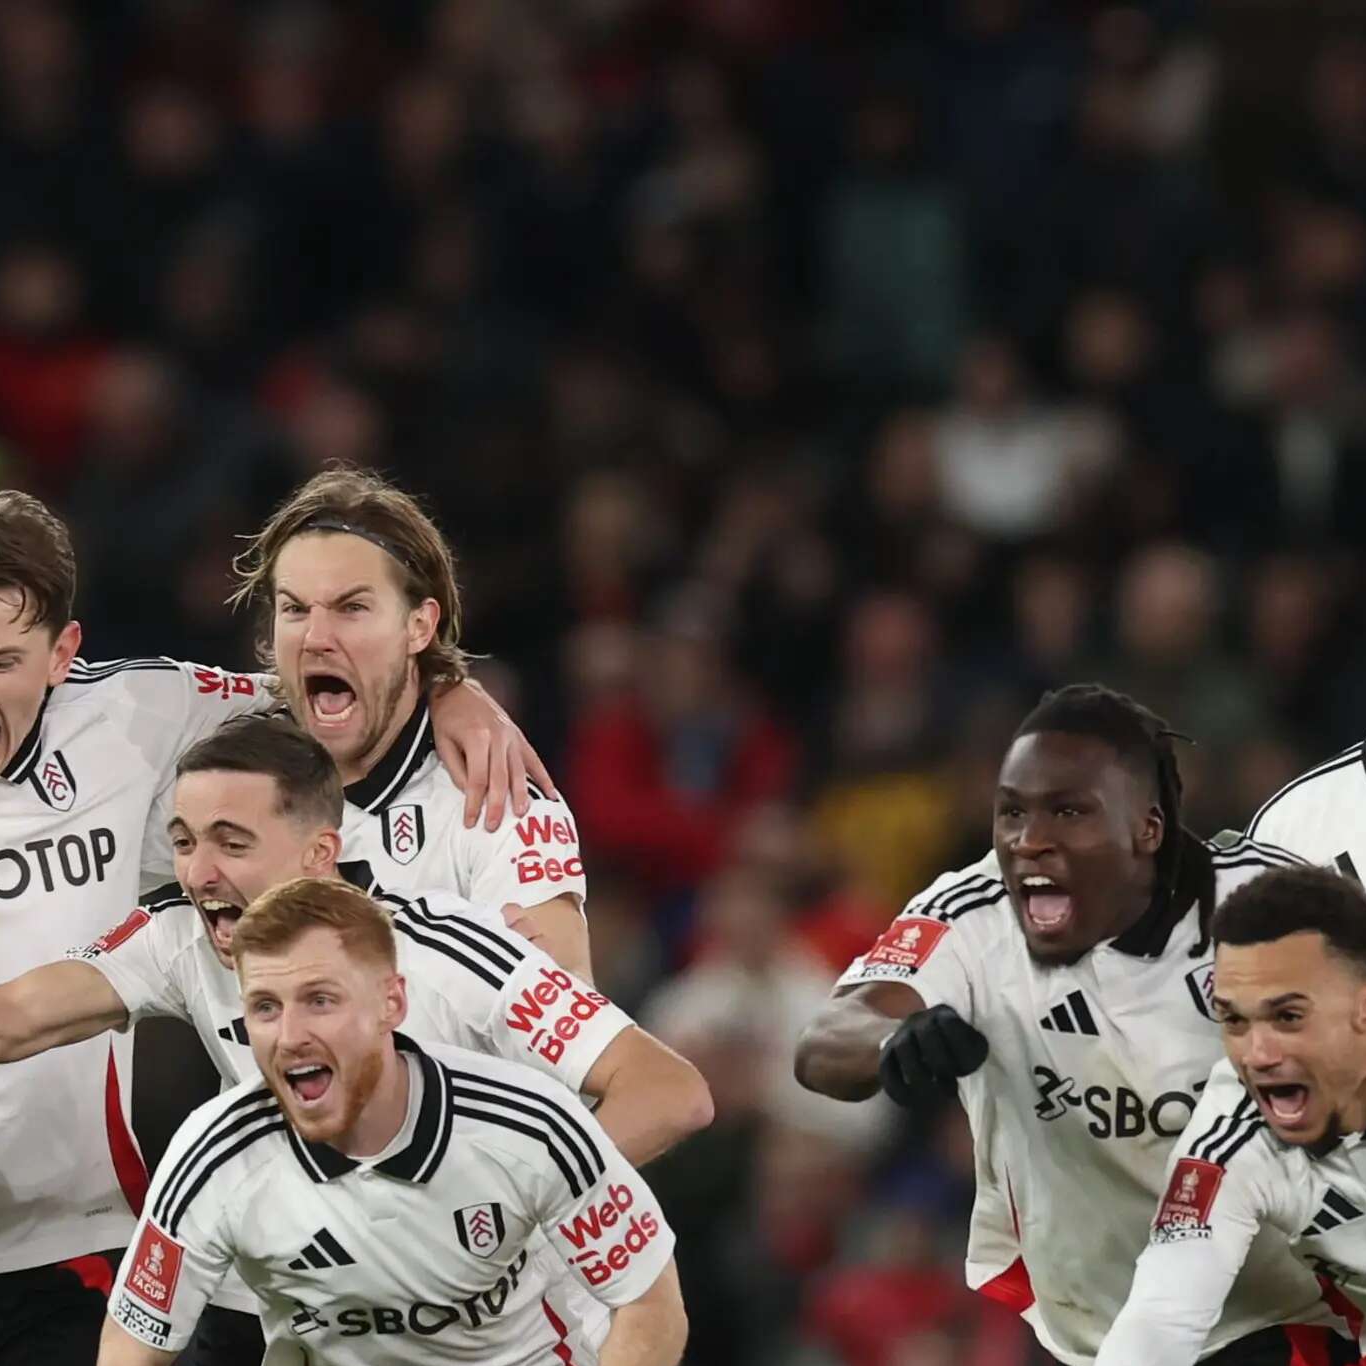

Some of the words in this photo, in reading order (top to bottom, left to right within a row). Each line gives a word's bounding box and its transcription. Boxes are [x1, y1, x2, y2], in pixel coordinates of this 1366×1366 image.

[511, 850, 584, 884] Be
[506, 967, 573, 1034] Web
[527, 990, 611, 1065] Beds
[1085, 1080, 1209, 1139] SBO
[558, 1183, 634, 1250] Web
[567, 1211, 659, 1287] Beds
[144, 1281, 167, 1302] CUP
[337, 1249, 528, 1337] SBOTOP
